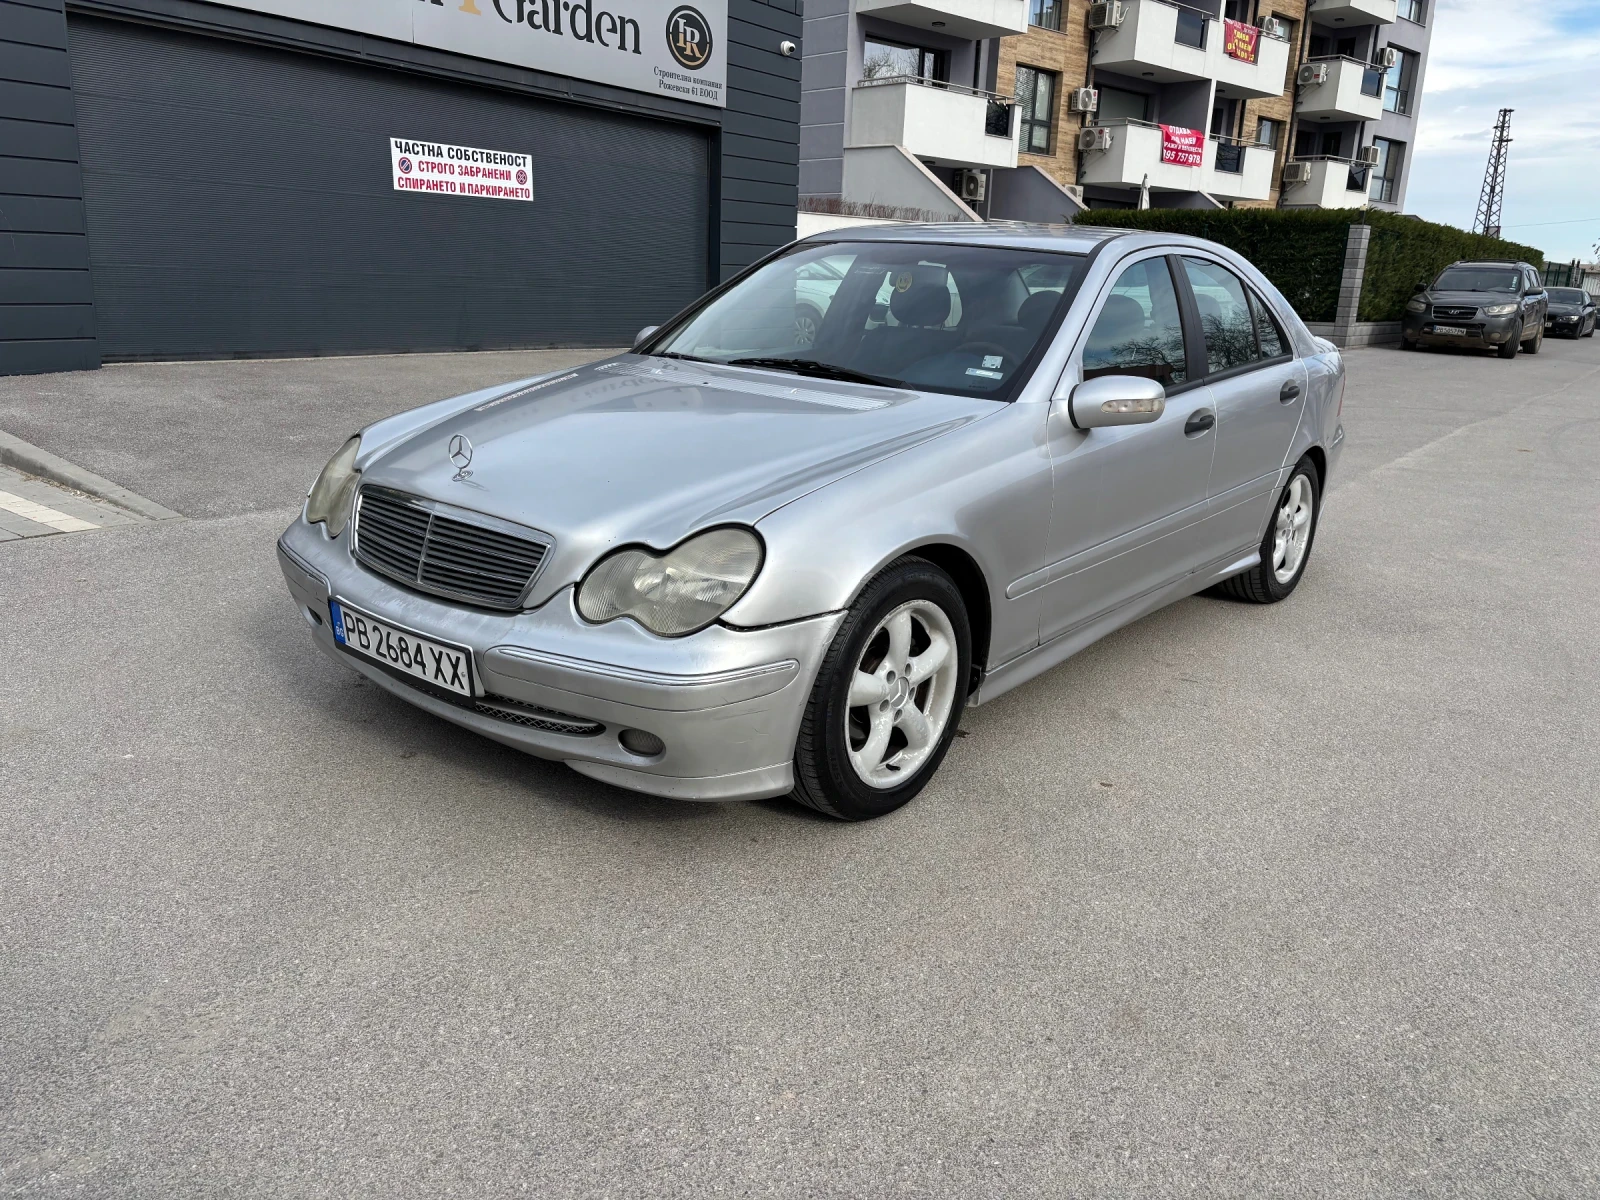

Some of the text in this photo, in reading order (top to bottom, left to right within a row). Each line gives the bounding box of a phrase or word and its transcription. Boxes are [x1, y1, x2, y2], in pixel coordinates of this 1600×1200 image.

[653, 65, 723, 89] Строителна компания
[658, 79, 718, 101] Рожевски 61 ЕООД
[394, 140, 528, 168] ЧАСТНА СОБСТВЕНОСТ
[418, 160, 512, 181] СТРОГО ЗАБРАНЕНИ
[397, 176, 530, 199] СПИРАНЕТО И ПАРКИРАНЕТО
